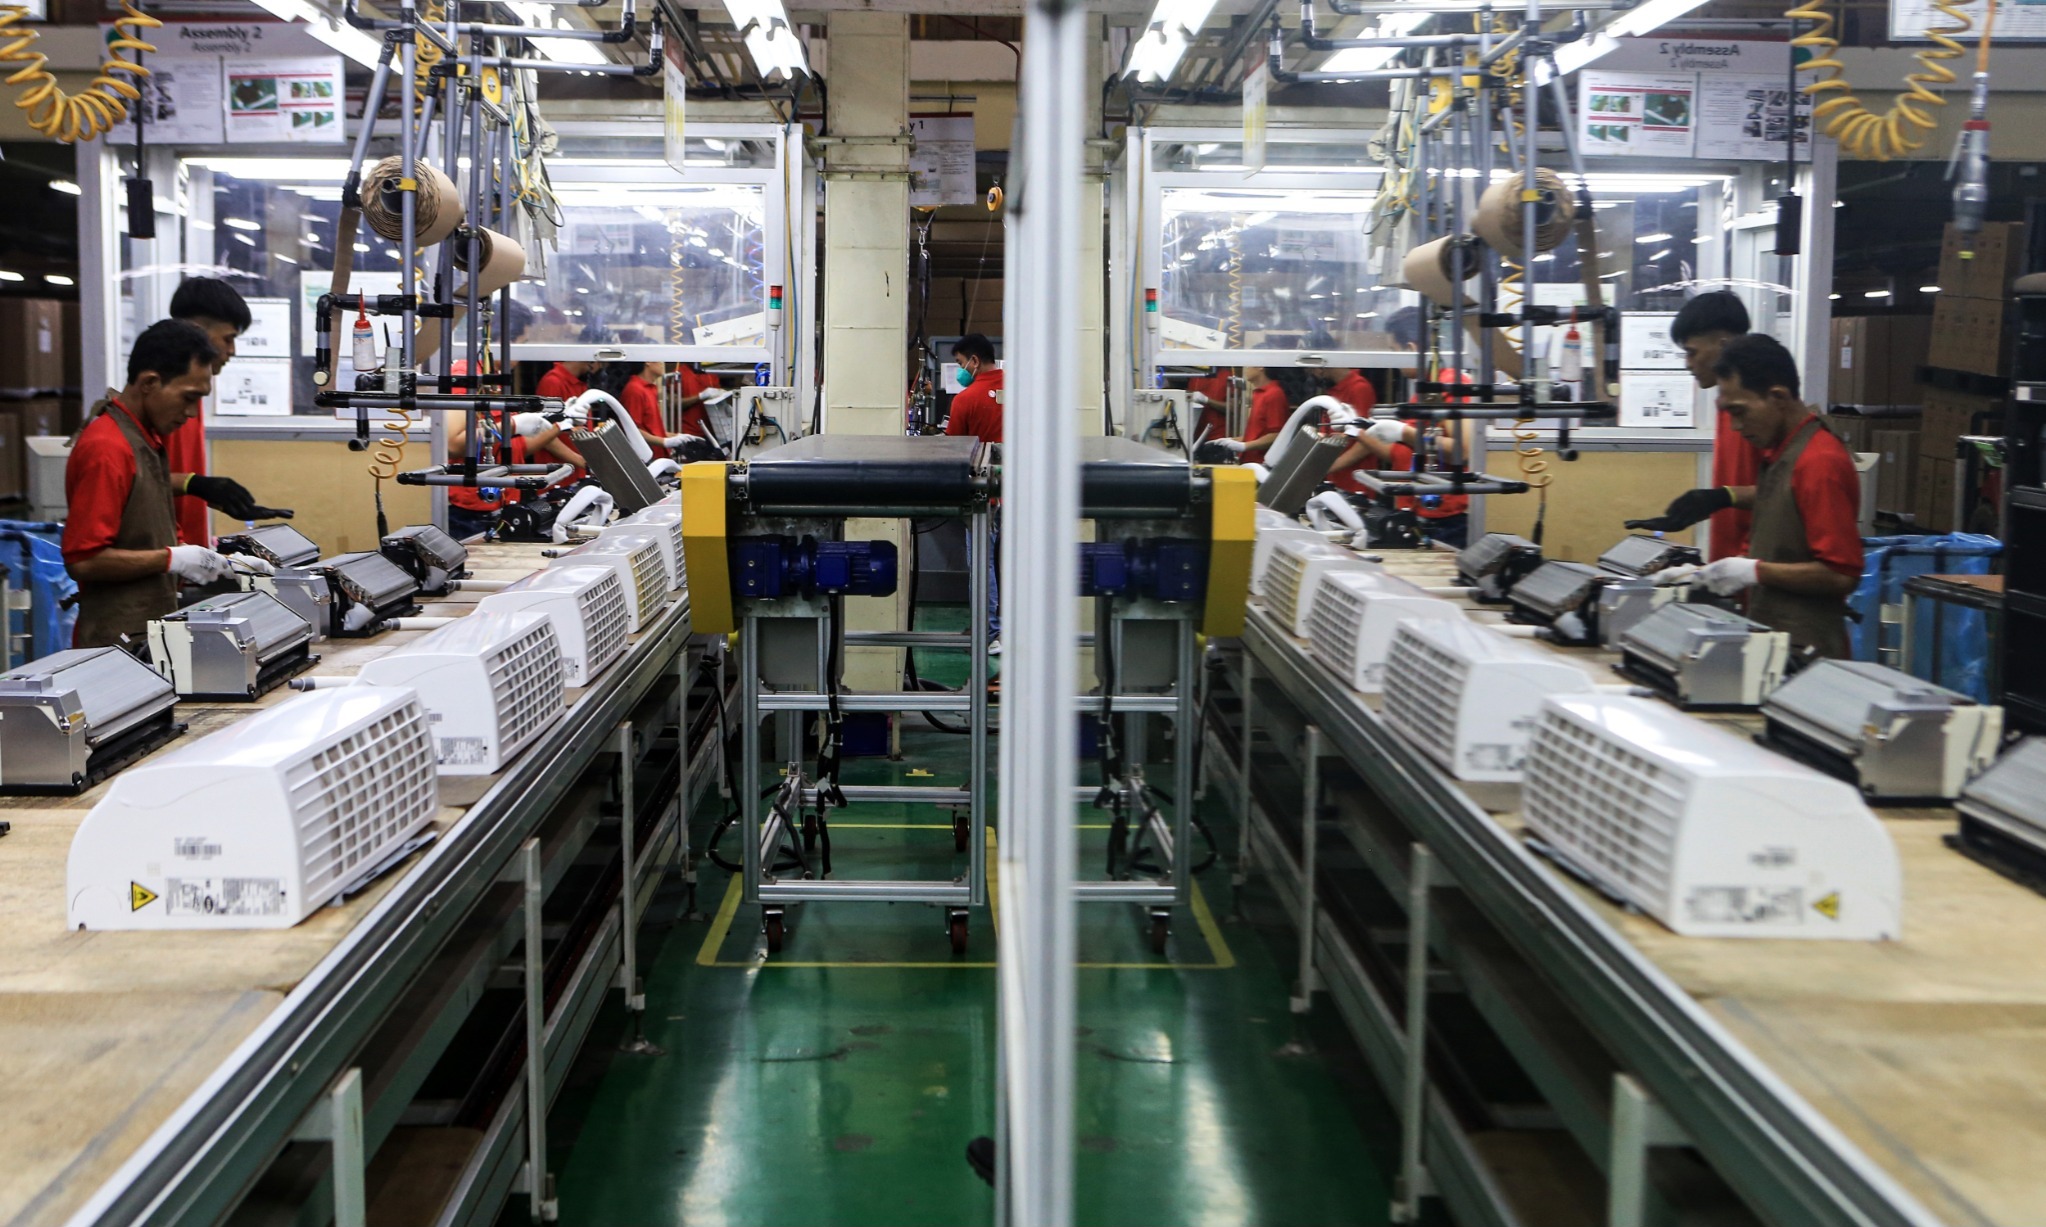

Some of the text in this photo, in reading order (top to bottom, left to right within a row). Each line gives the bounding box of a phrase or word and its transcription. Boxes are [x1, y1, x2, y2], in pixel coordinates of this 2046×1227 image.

[179, 26, 262, 43] Assembly 2
[191, 42, 252, 54] Assembly 2
